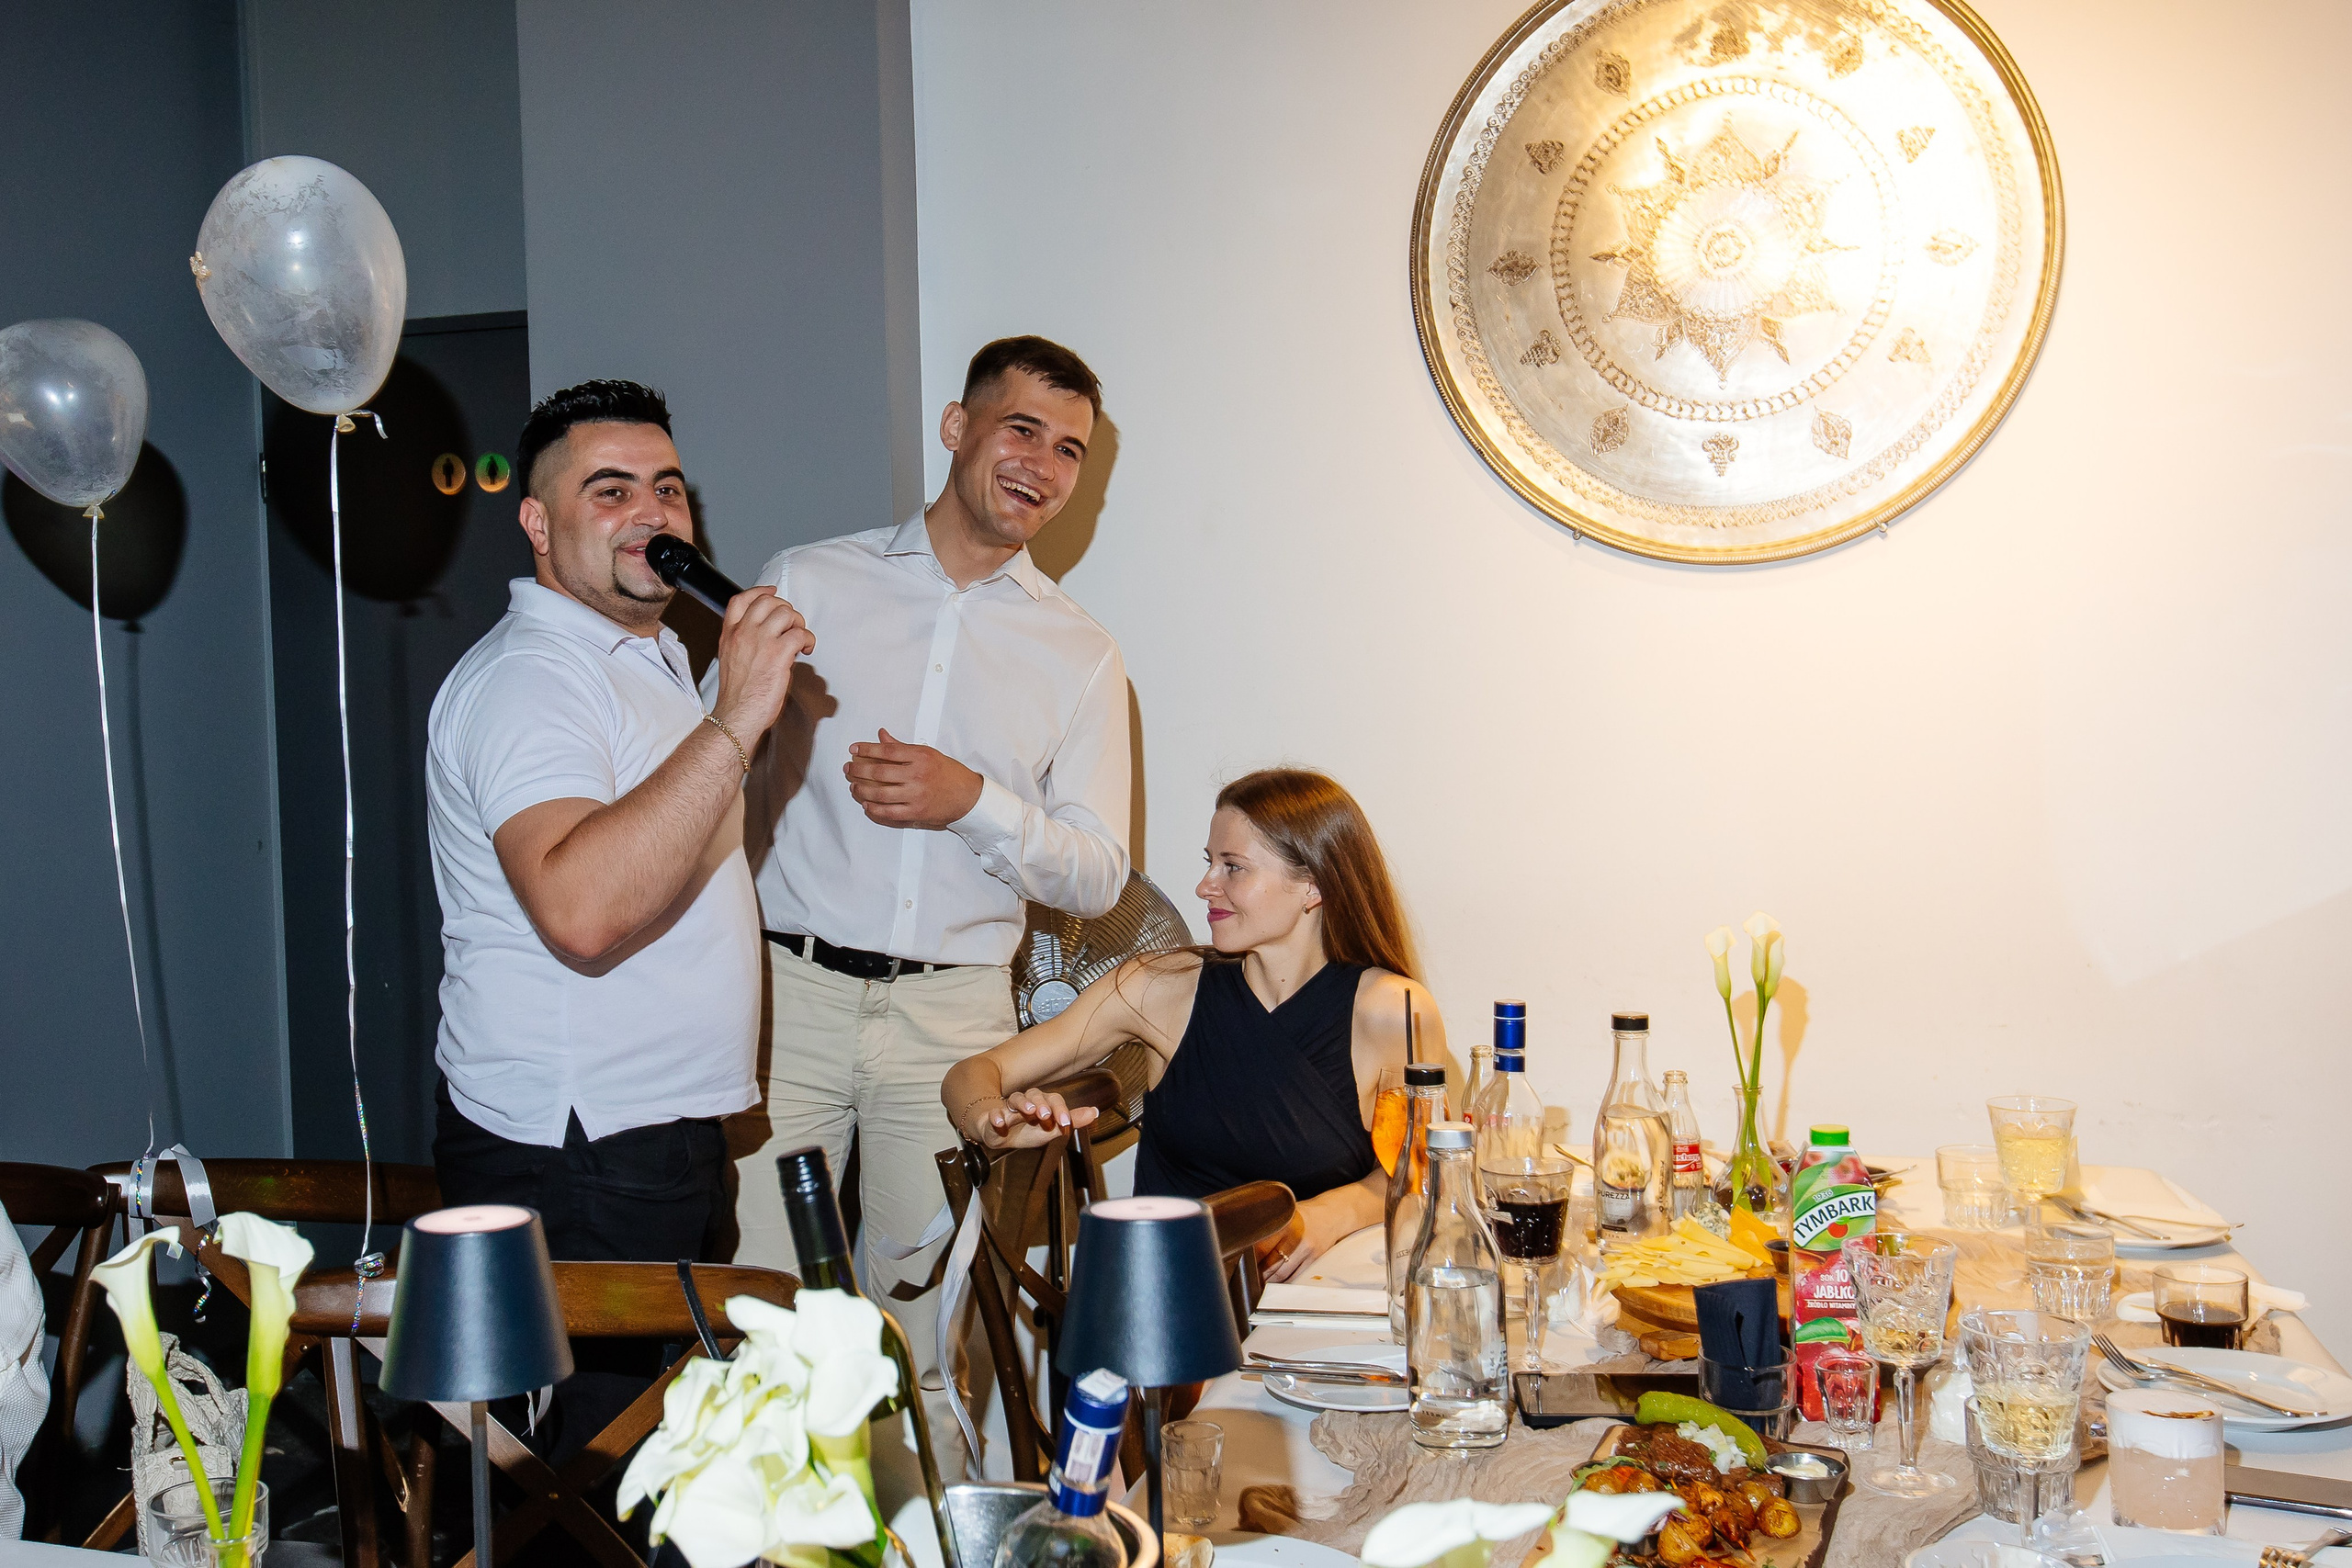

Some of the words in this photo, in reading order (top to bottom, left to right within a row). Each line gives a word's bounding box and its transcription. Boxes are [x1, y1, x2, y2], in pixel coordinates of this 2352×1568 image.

[1597, 1189, 1631, 1201] PUREZZA
[1813, 1189, 1834, 1202] 1936
[1793, 1195, 1876, 1239] TYMBARK
[1820, 1273, 1835, 1282] SOK
[1836, 1269, 1849, 1283] 10
